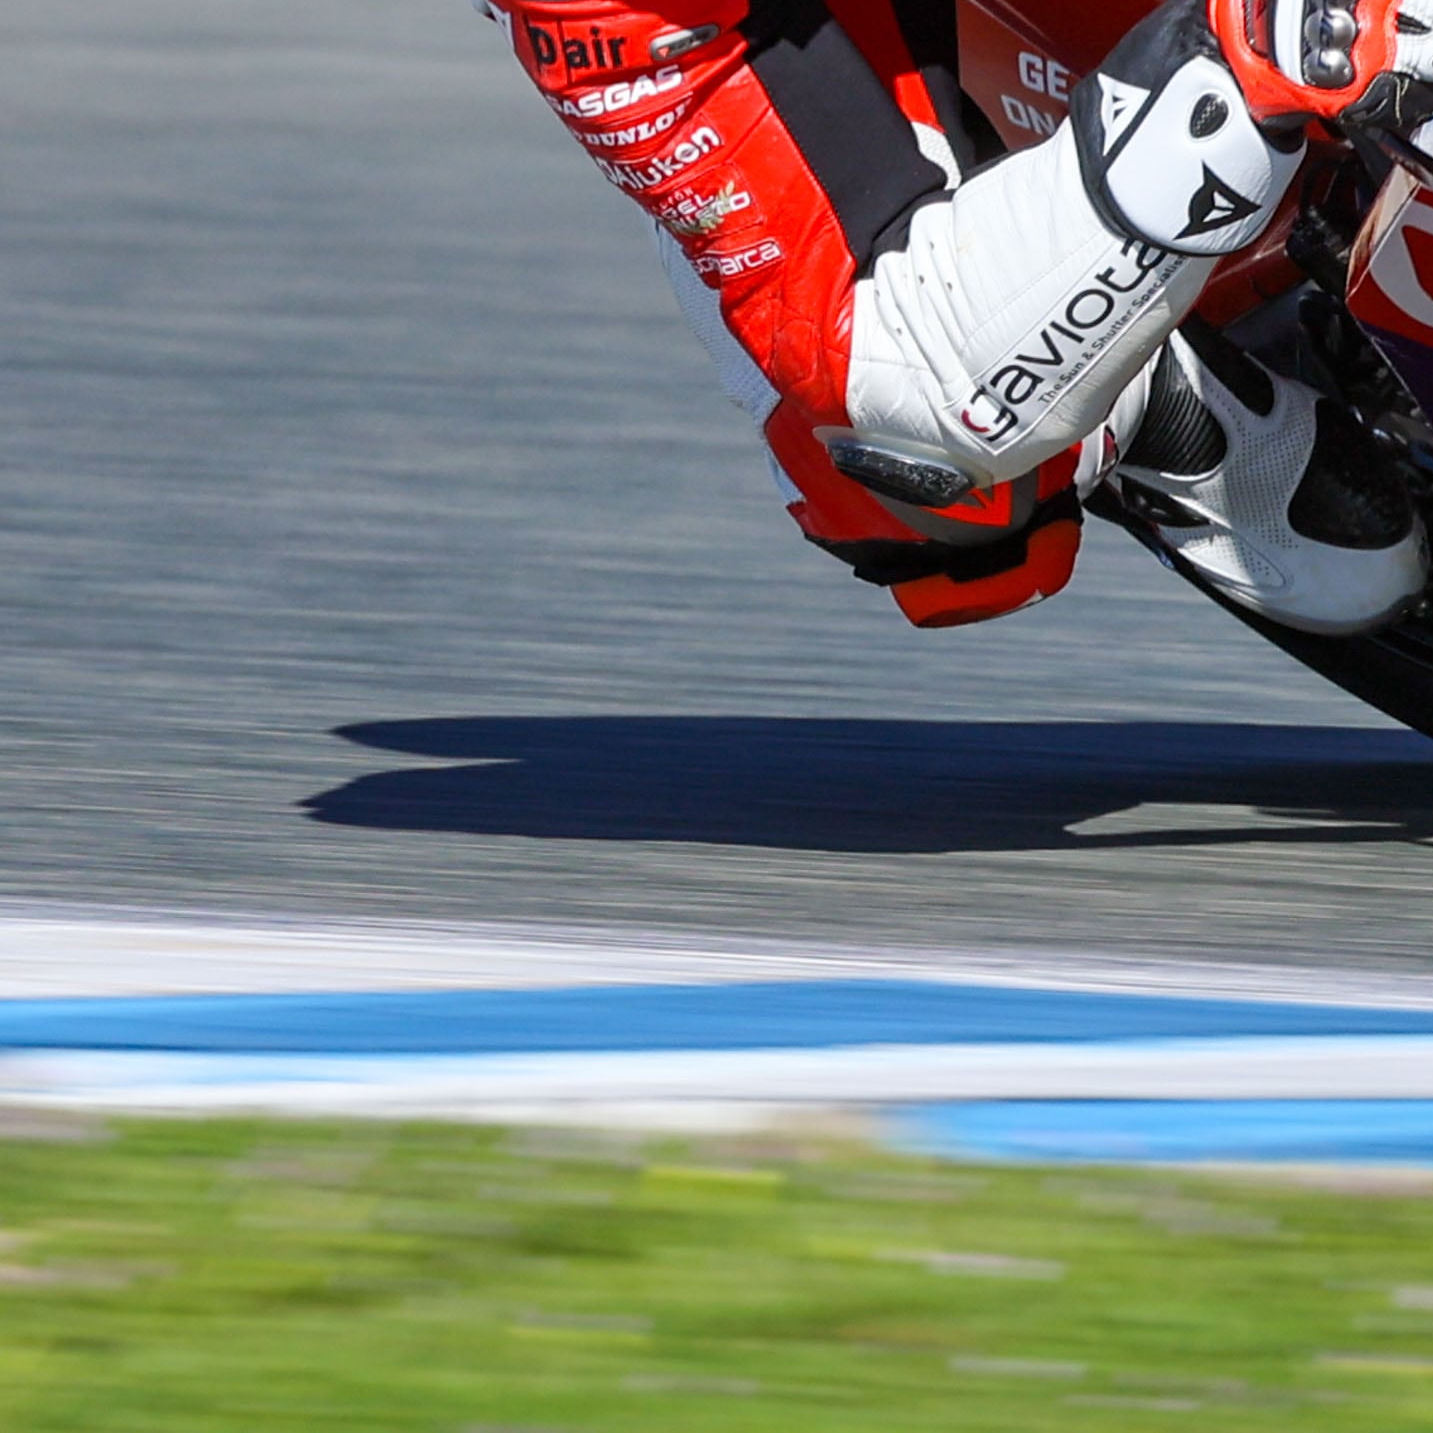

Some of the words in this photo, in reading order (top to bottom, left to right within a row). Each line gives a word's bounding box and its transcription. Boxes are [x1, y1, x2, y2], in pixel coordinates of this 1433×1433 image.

[545, 64, 683, 118] GASGAS
[960, 238, 1169, 443] gaviota
[1038, 379, 1064, 405] The
[1058, 352, 1087, 388] Sun
[1090, 304, 1135, 351] Shutter
